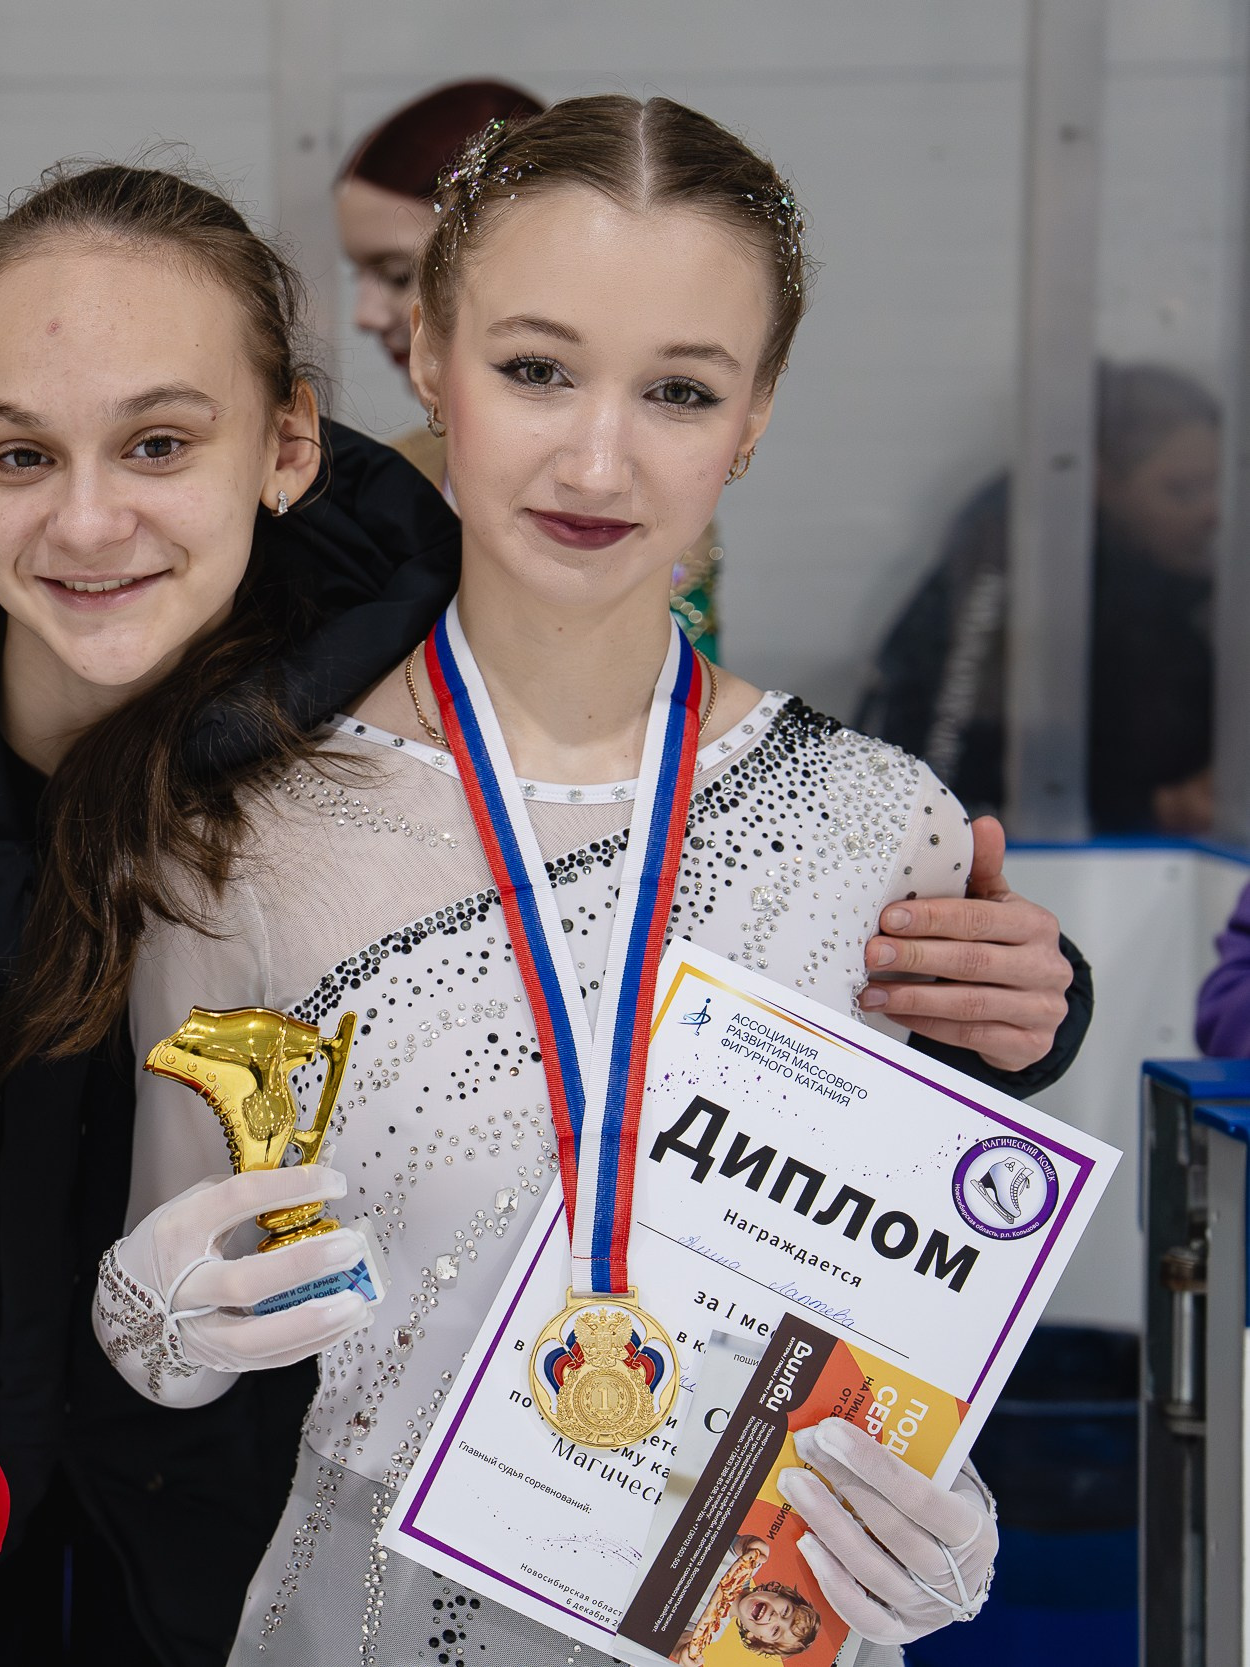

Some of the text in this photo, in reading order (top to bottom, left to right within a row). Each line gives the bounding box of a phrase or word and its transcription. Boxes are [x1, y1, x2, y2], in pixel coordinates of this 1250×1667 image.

[732, 1013, 818, 1060] АССОЦИАЦИЯ
[721, 1038, 850, 1106] ФИГУРНОГО КАТАНИЯ
[726, 1025, 867, 1099] РАЗВИТИЯ МАССОВОГО
[649, 1094, 980, 1293] Диплом
[955, 1184, 976, 1226] Новосибирская
[1012, 1222, 1039, 1237] Кольцово
[723, 1209, 862, 1288] Награждается
[296, 1285, 311, 1294] СНГ
[694, 1291, 720, 1312] за
[509, 1390, 532, 1408] по
[837, 1386, 852, 1404] ОТ
[859, 1375, 874, 1393] НА
[761, 1425, 775, 1446] Размер
[458, 1441, 592, 1514] Главный судья соревнований:
[766, 1502, 791, 1540] ВИЛБИ
[520, 1563, 623, 1617] Новосибирская област
[572, 1602, 610, 1624] декабря
[661, 1614, 673, 1631] можно
